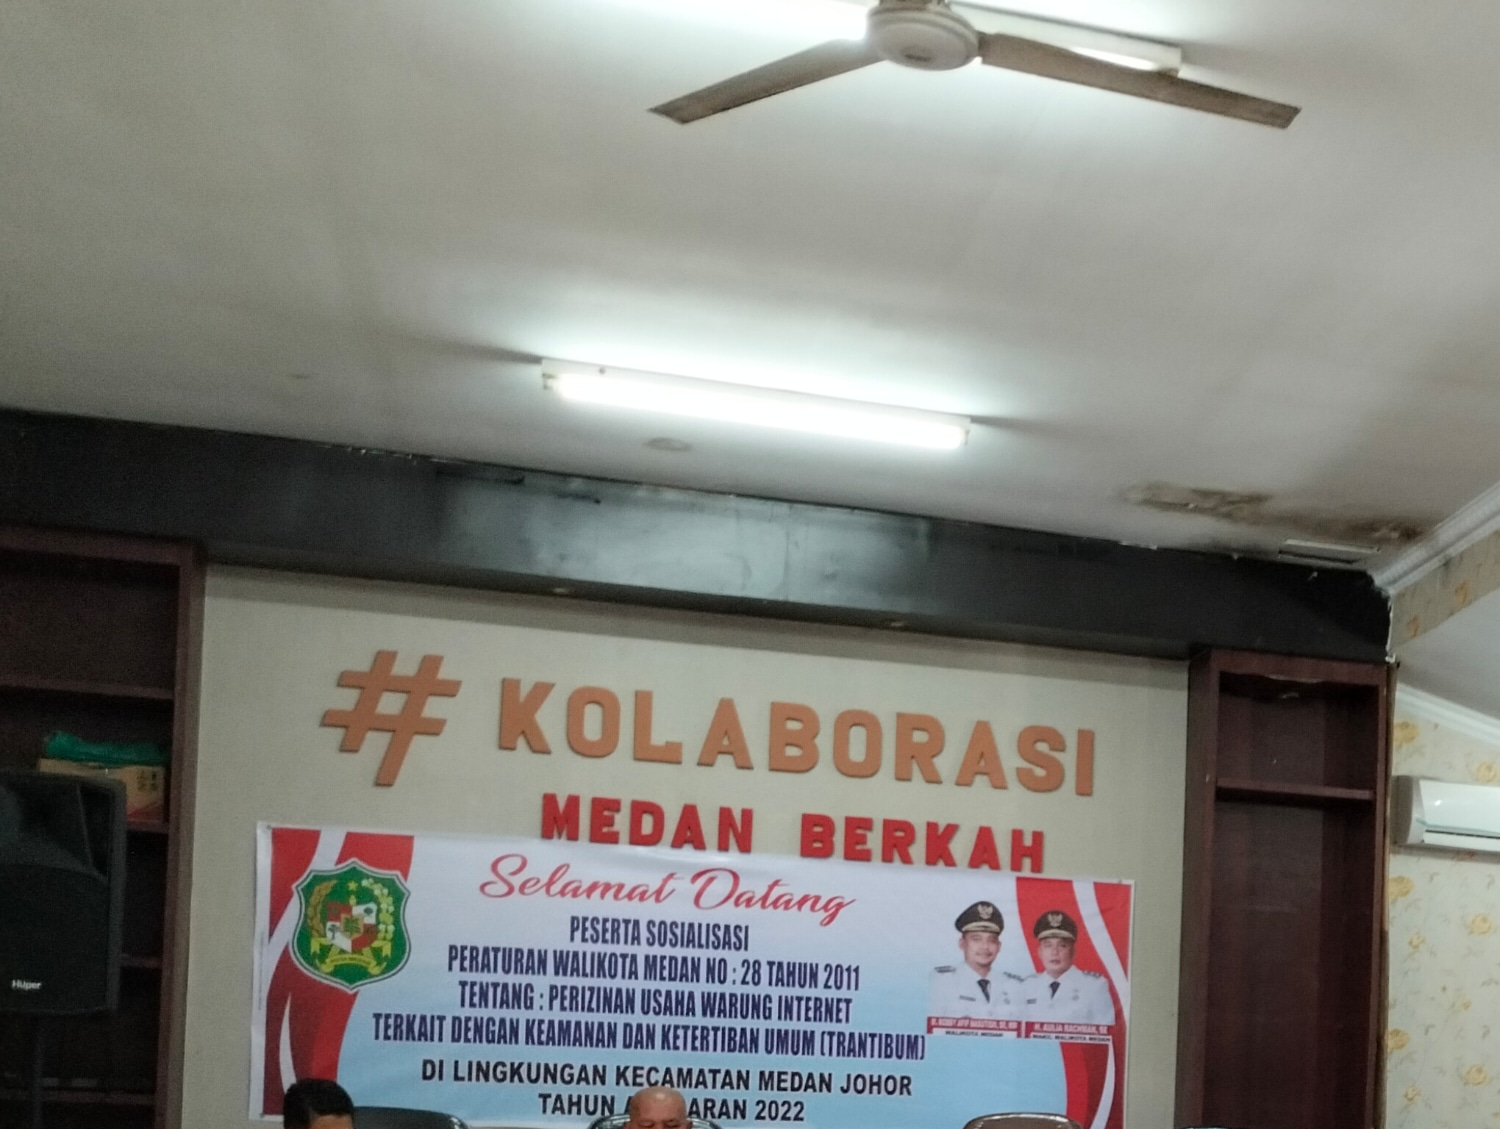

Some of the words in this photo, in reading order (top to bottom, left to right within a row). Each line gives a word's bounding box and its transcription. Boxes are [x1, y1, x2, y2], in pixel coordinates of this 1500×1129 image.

[498, 677, 1096, 797] KOLABORASI
[541, 792, 753, 854] MEDAN
[800, 813, 1045, 874] BERKAH
[479, 853, 684, 904] Selamat
[690, 868, 857, 927] Datang
[569, 915, 641, 947] PESERTA
[645, 919, 750, 951] SOSIALISASI
[448, 944, 548, 976] PERATURAN
[553, 949, 639, 981] WALIKOTA
[643, 954, 700, 984] MEDAN
[706, 957, 728, 985] NO
[740, 959, 762, 987] 28
[766, 960, 819, 989] TAHUN
[823, 963, 861, 992] 2011
[458, 980, 535, 1011] TENTANG
[549, 984, 636, 1016] PERIZINAN
[641, 988, 697, 1018] USAHA
[701, 991, 773, 1021] WARUNG
[777, 995, 853, 1024] INTERNET
[372, 1012, 447, 1043] TERKAIT
[451, 1015, 520, 1046] DENGAN
[525, 1018, 618, 1049] KEAMANAN
[622, 1022, 656, 1050] DAN
[661, 1023, 760, 1055] KETERTIBAN
[764, 1028, 816, 1057] UMUM
[819, 1030, 926, 1061] (TRANTIBUM)
[421, 1059, 444, 1081] DI
[453, 1060, 607, 1086] LINGKUNGAN
[615, 1065, 751, 1091] KECAMATAN
[758, 1070, 833, 1094] MEDAN
[839, 1073, 913, 1096] JOHOR
[538, 1093, 615, 1116] TAHUN
[754, 1099, 805, 1122] 2022
